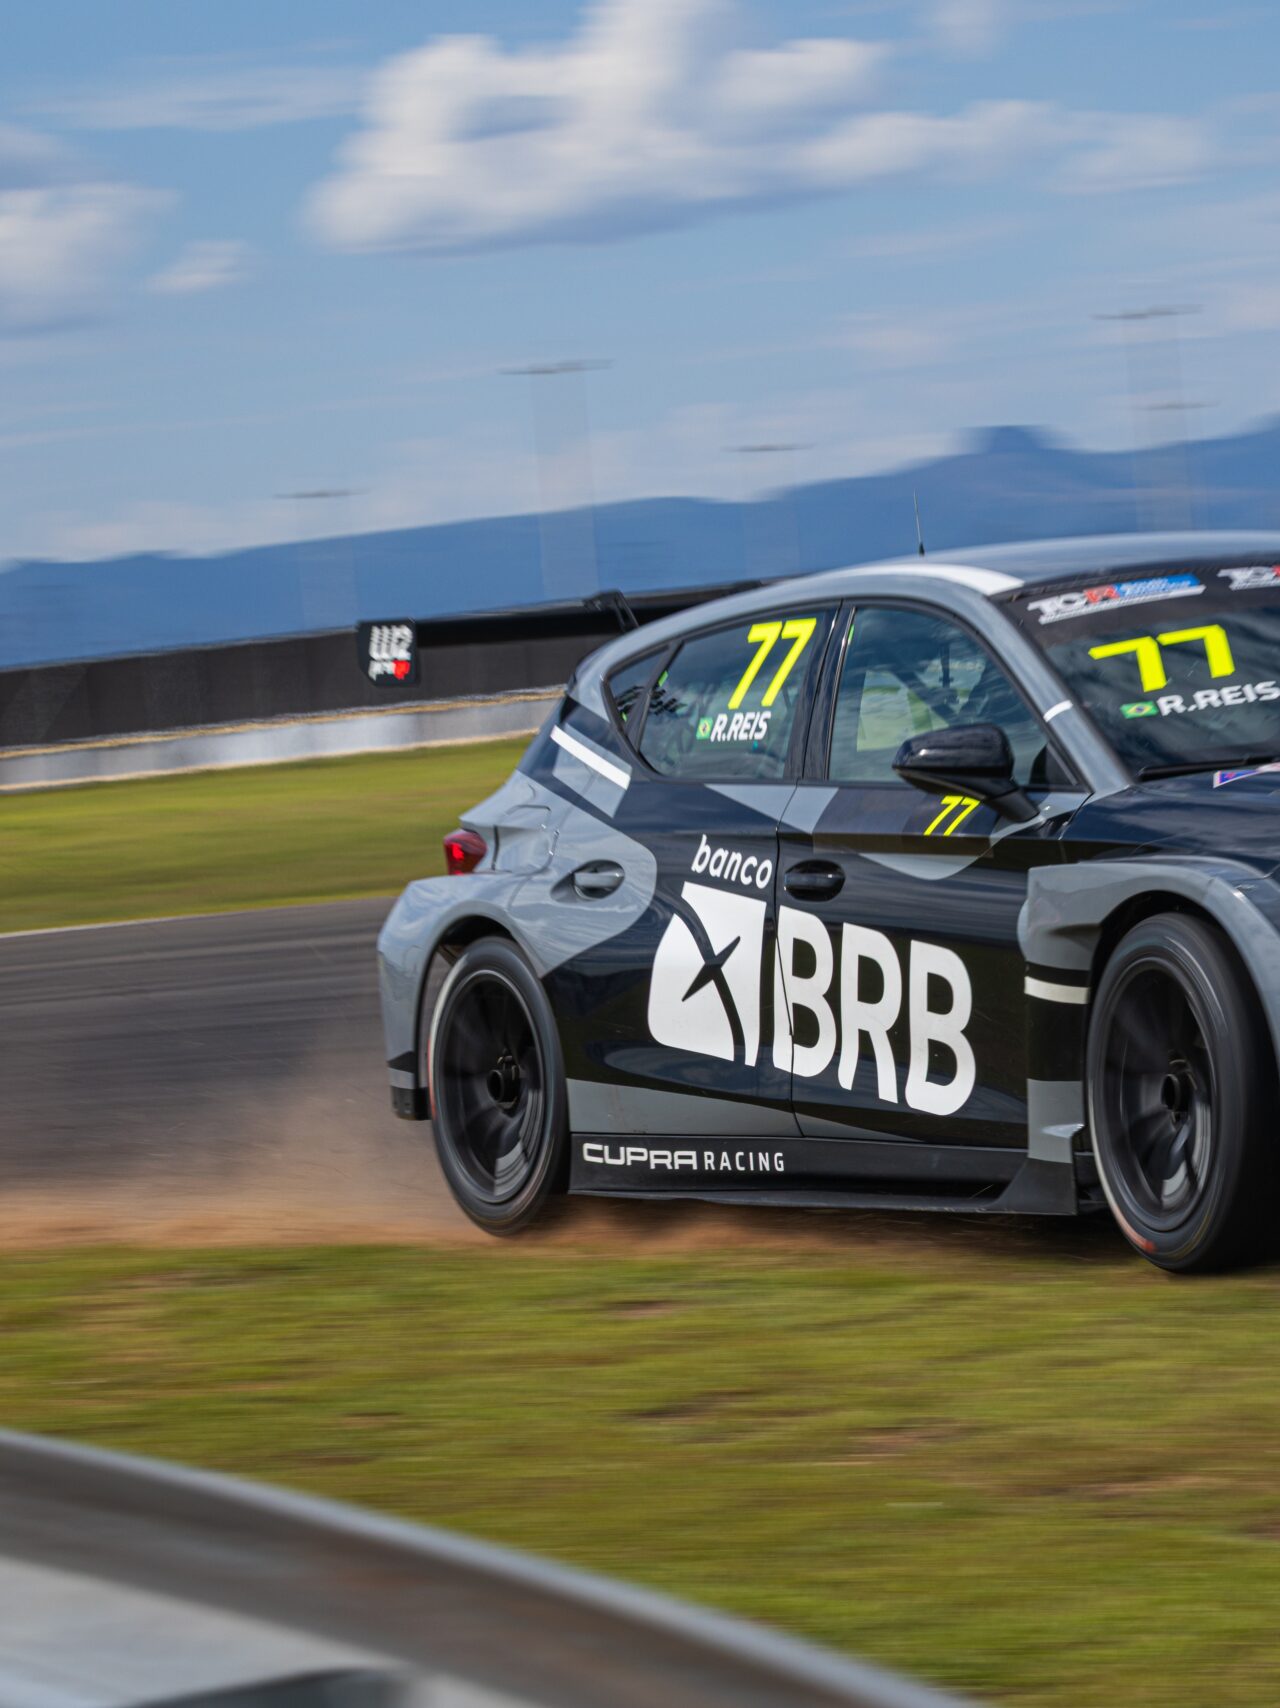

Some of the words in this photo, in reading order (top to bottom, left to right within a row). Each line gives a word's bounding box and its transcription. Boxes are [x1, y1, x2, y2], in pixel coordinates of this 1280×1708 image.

[728, 618, 816, 709] 77
[1088, 624, 1235, 692] 77
[710, 711, 771, 742] R.REIS
[923, 795, 980, 836] 77
[691, 834, 773, 889] banco
[773, 905, 976, 1116] BRB
[582, 1142, 698, 1170] CUPRA
[703, 1151, 784, 1171] RACING
